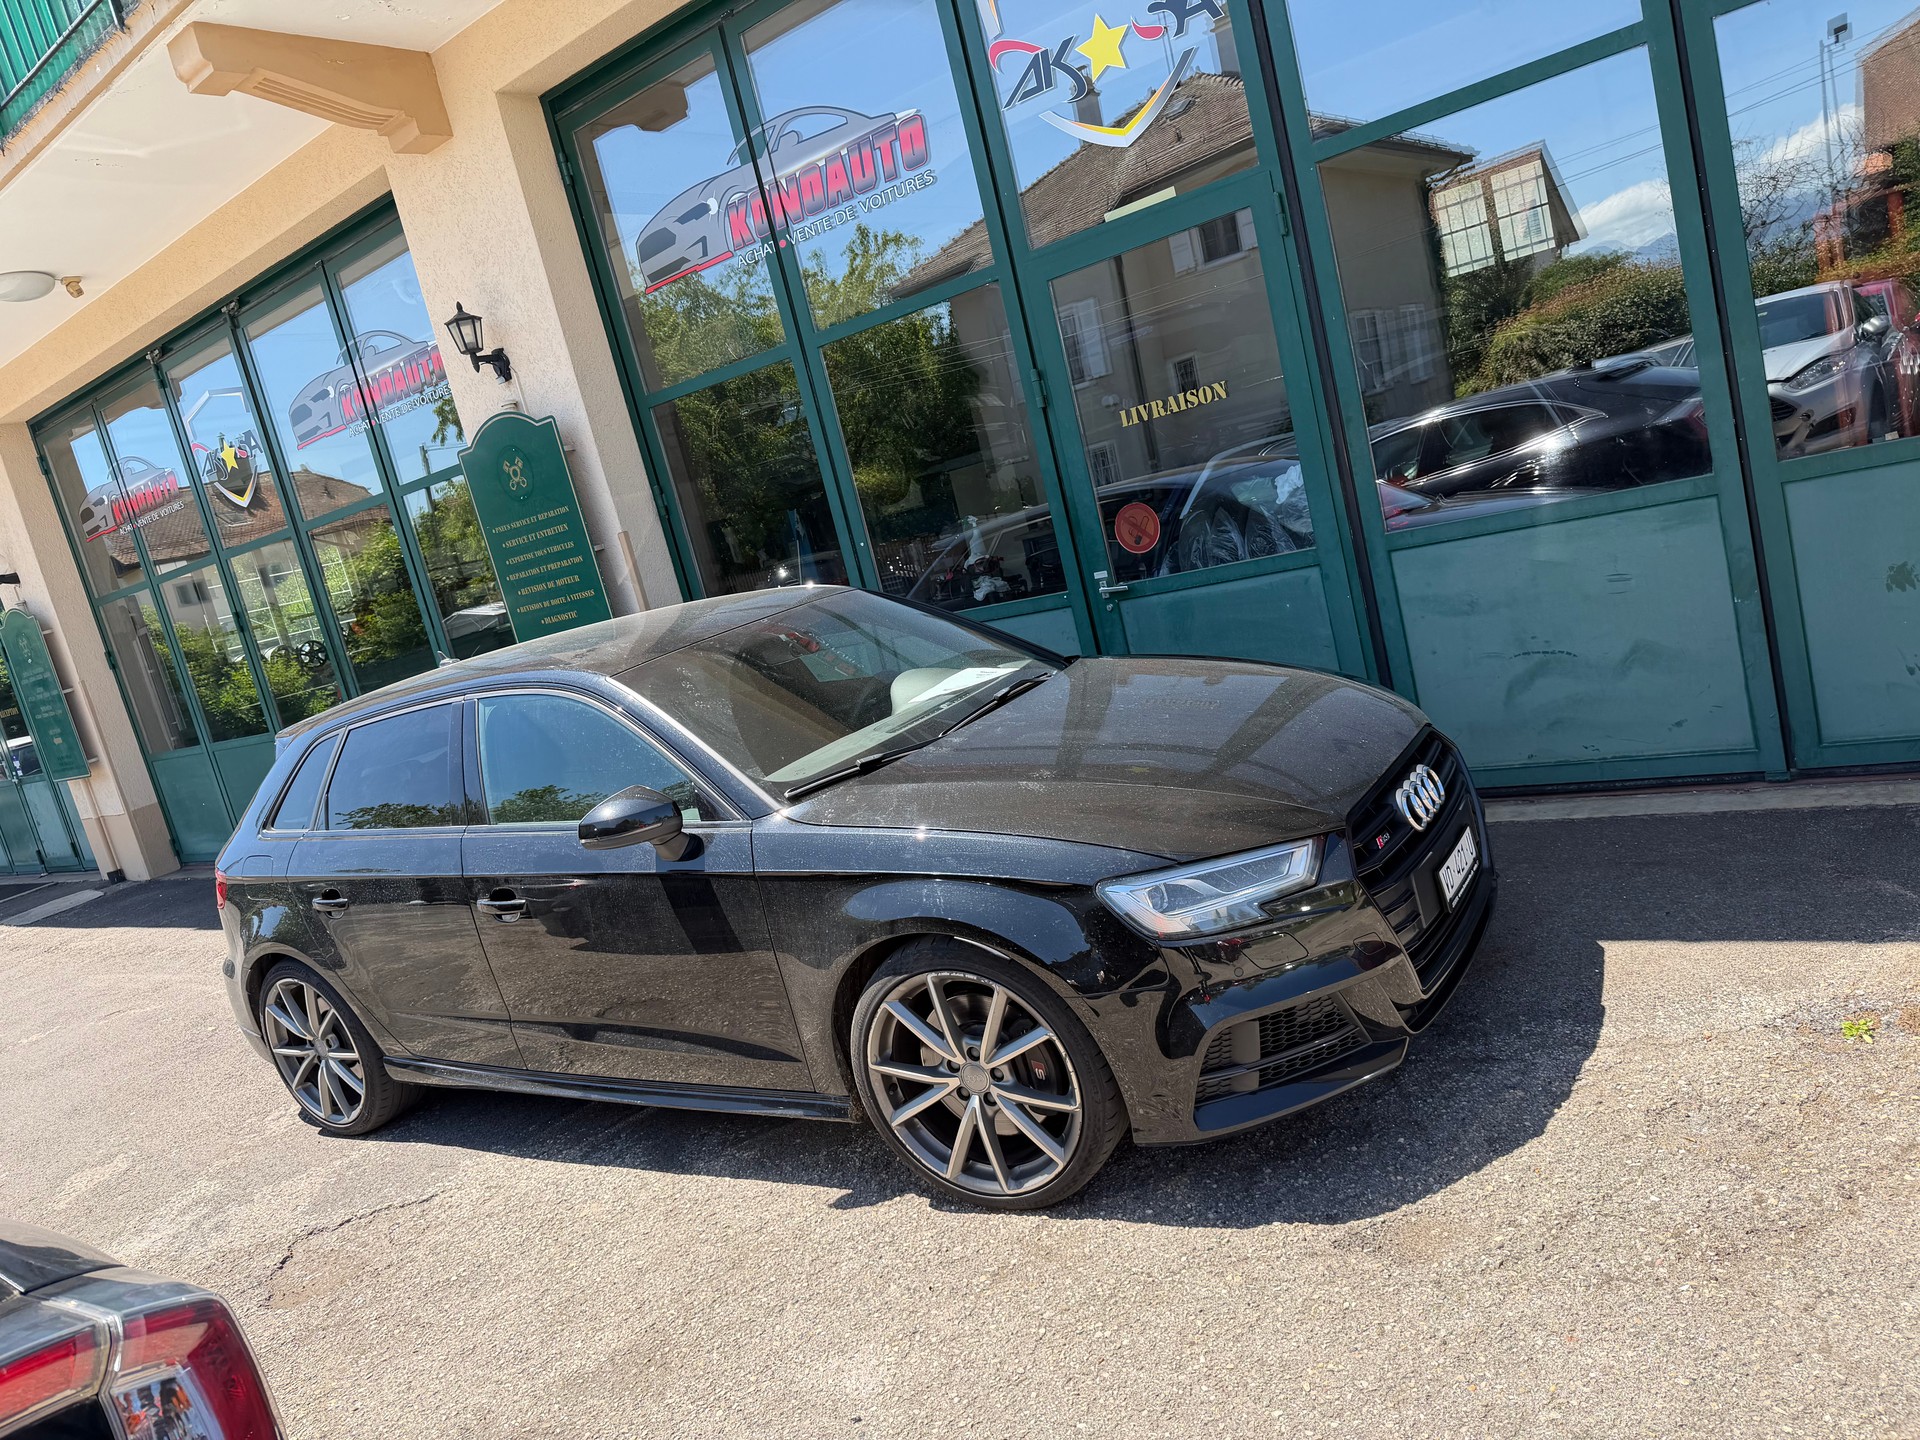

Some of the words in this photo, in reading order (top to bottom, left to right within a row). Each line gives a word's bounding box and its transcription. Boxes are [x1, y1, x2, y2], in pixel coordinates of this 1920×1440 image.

[727, 114, 929, 251] KONOAUTO
[738, 240, 776, 269] ACHAT
[786, 216, 832, 245] VENTE
[834, 206, 856, 227] DE
[859, 170, 935, 214] VOITURES
[340, 344, 448, 425] KONOAUTO
[1119, 380, 1228, 428] LIVRAISON
[349, 419, 371, 437] ACHAT
[374, 407, 400, 424] VENTE
[400, 402, 412, 414] DE
[111, 470, 180, 526] KONOAUTO
[135, 515, 152, 528] VENTE
[152, 511, 159, 521] DE
[160, 500, 185, 517] VOITURES
[511, 517, 531, 529] SERVICE
[505, 535, 529, 548] SERVICE
[529, 533, 537, 541] ET
[537, 523, 569, 539] ENTRETIEN
[509, 552, 535, 565] EXPERTISE
[535, 549, 547, 558] TOUS
[540, 565, 547, 573] ET
[547, 581, 555, 589] DE
[556, 575, 580, 587] MOTEUR
[543, 600, 550, 608] DE
[570, 588, 595, 600] VITESSES
[544, 610, 578, 624] DIAGNOSTIC
